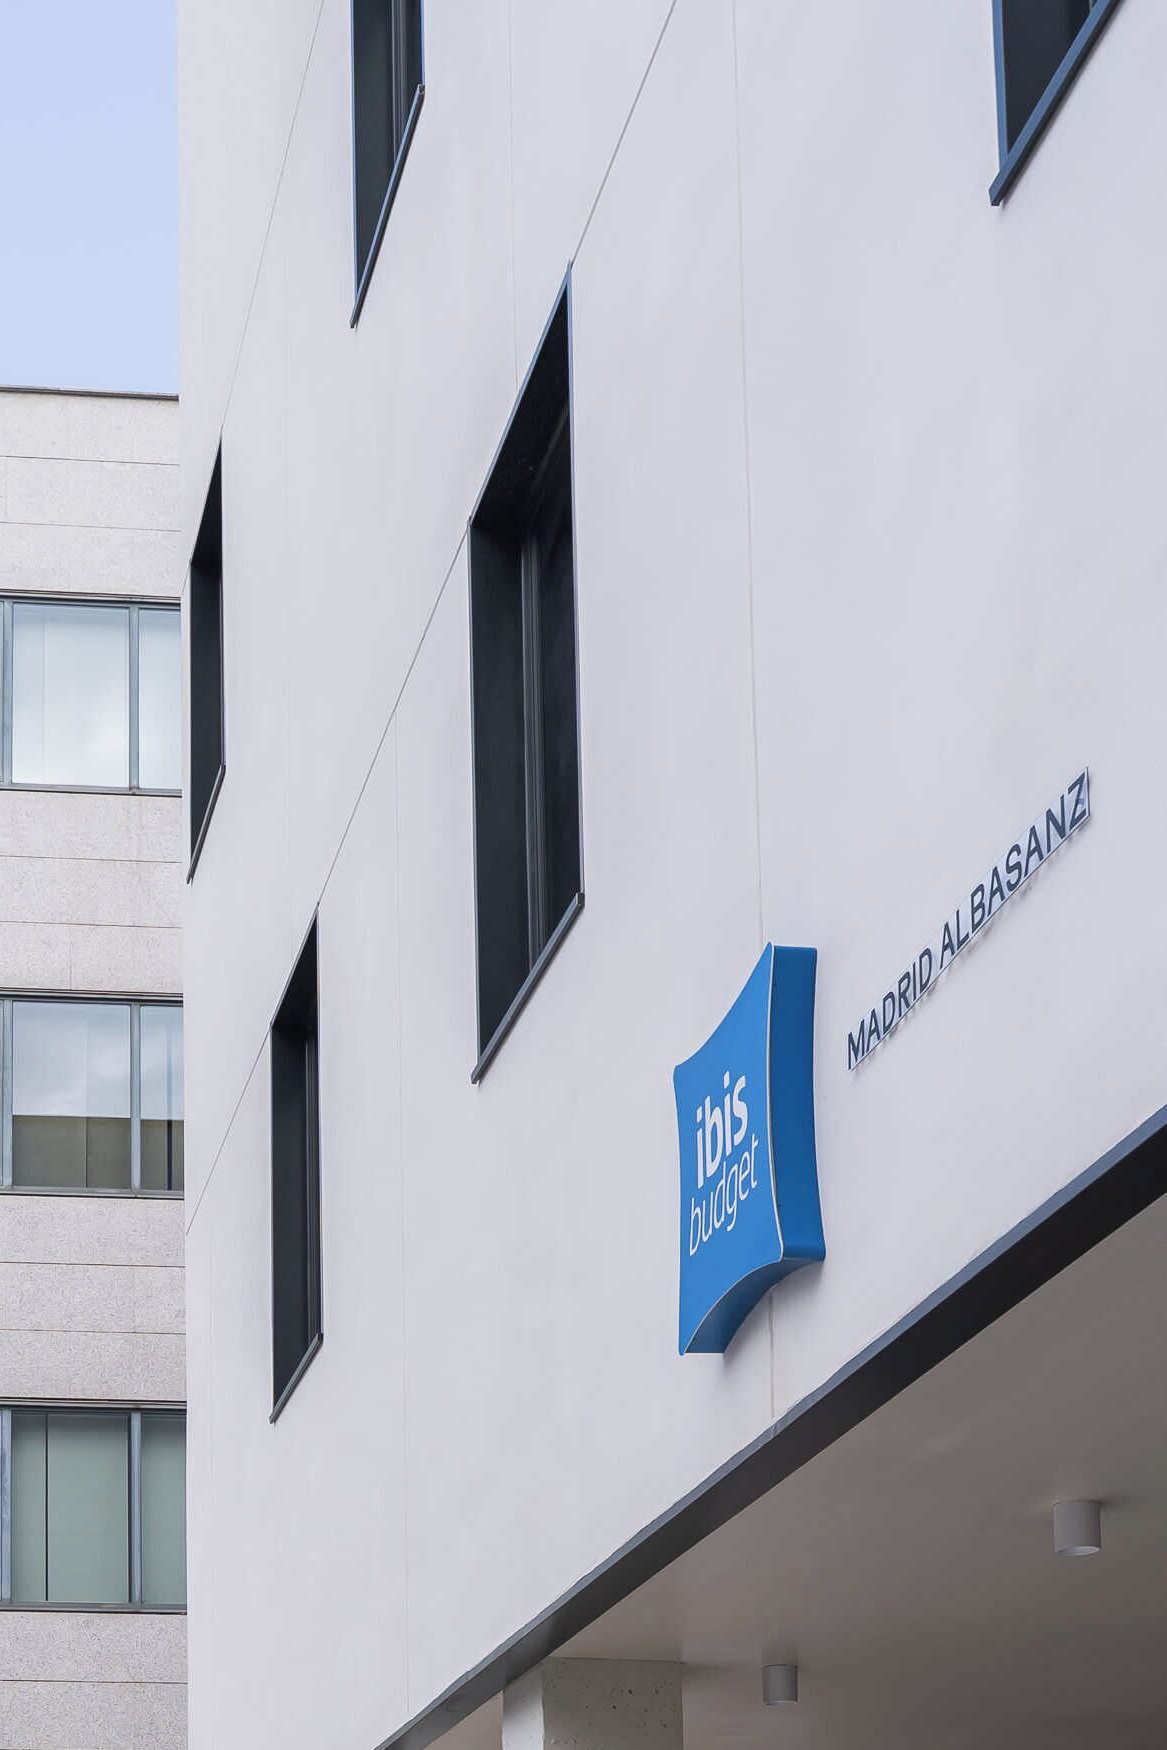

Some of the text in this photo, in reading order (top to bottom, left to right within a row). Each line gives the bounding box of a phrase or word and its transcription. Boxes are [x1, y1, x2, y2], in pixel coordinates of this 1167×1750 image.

[847, 771, 1087, 1071] MADRID ALBASANZ
[696, 1070, 748, 1189] ibis
[689, 1132, 759, 1257] budget
